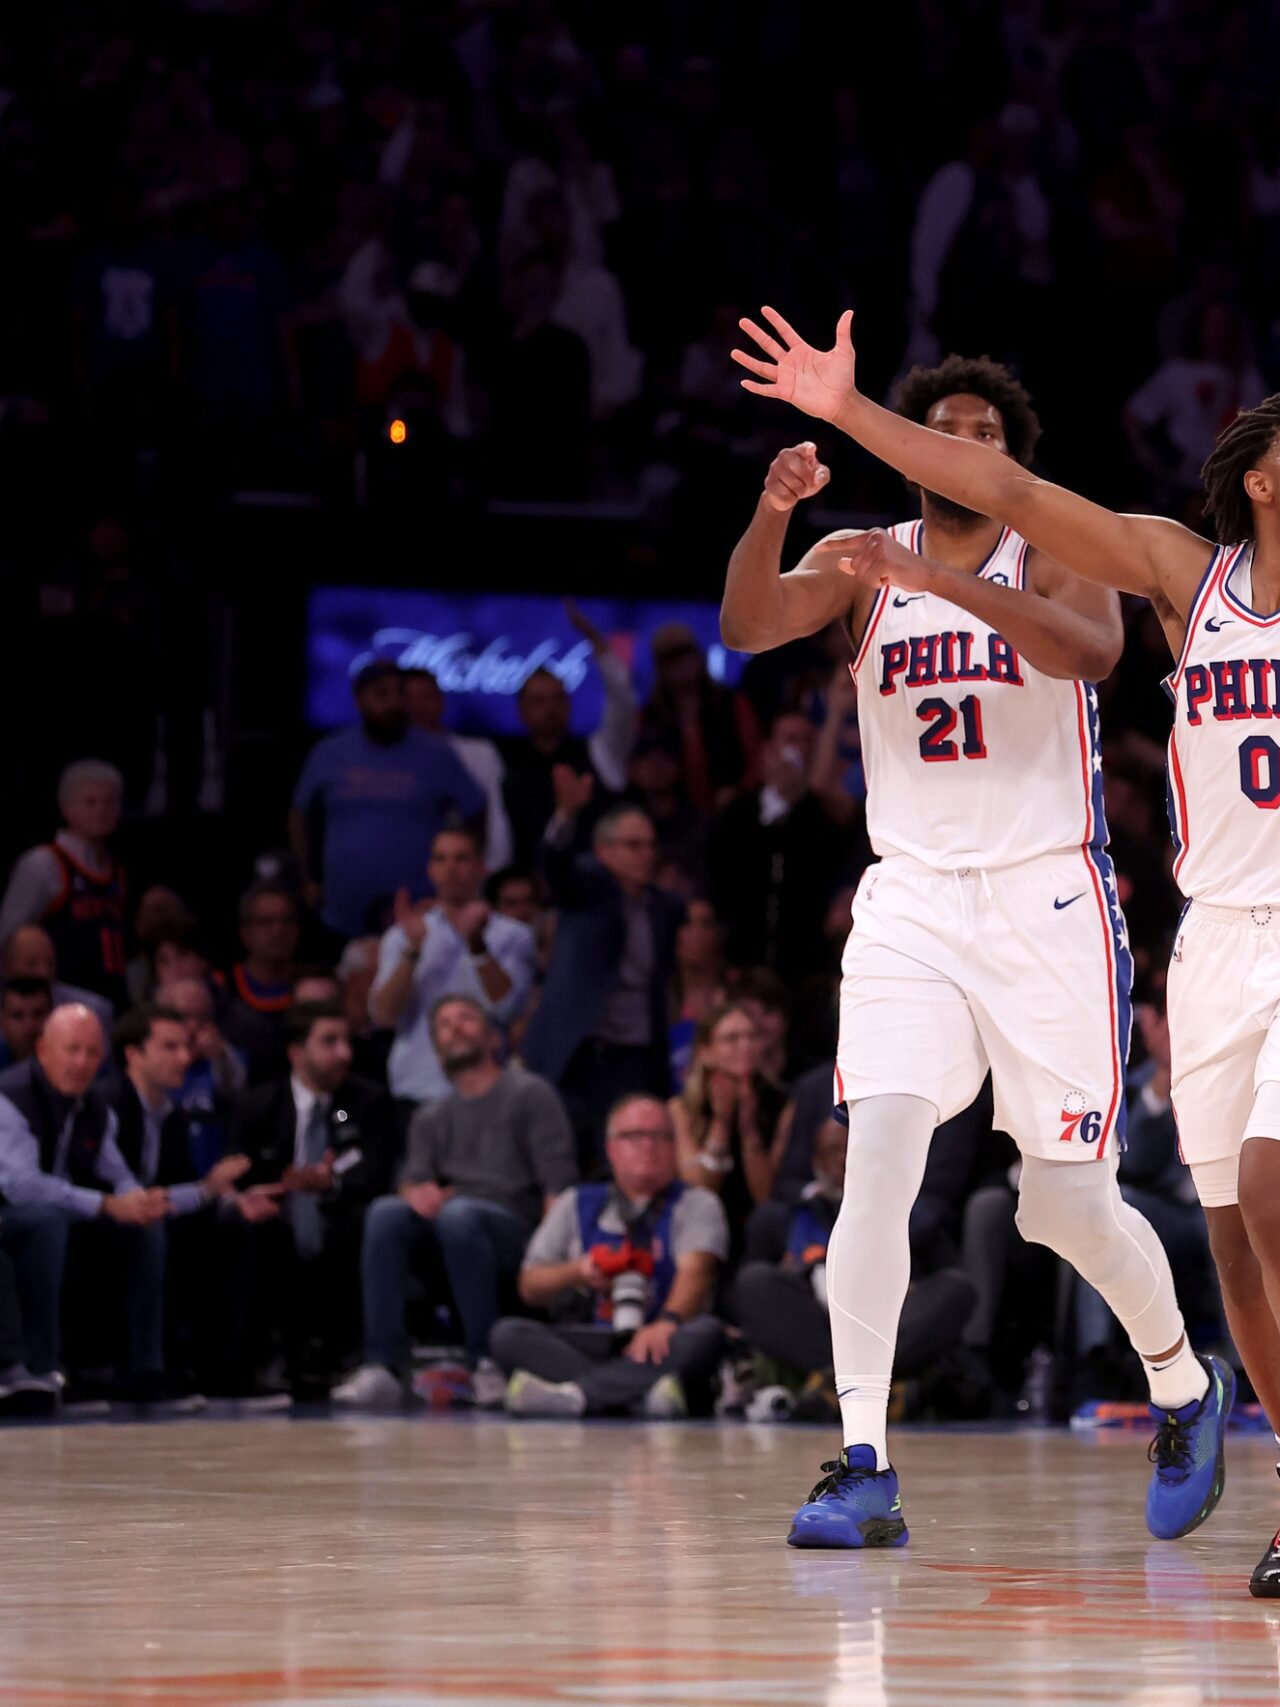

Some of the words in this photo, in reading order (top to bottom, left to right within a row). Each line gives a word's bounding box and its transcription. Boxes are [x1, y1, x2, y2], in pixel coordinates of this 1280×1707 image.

[880, 631, 1024, 696] PHILA
[916, 694, 987, 762] 21
[1059, 1109, 1102, 1144] 76
